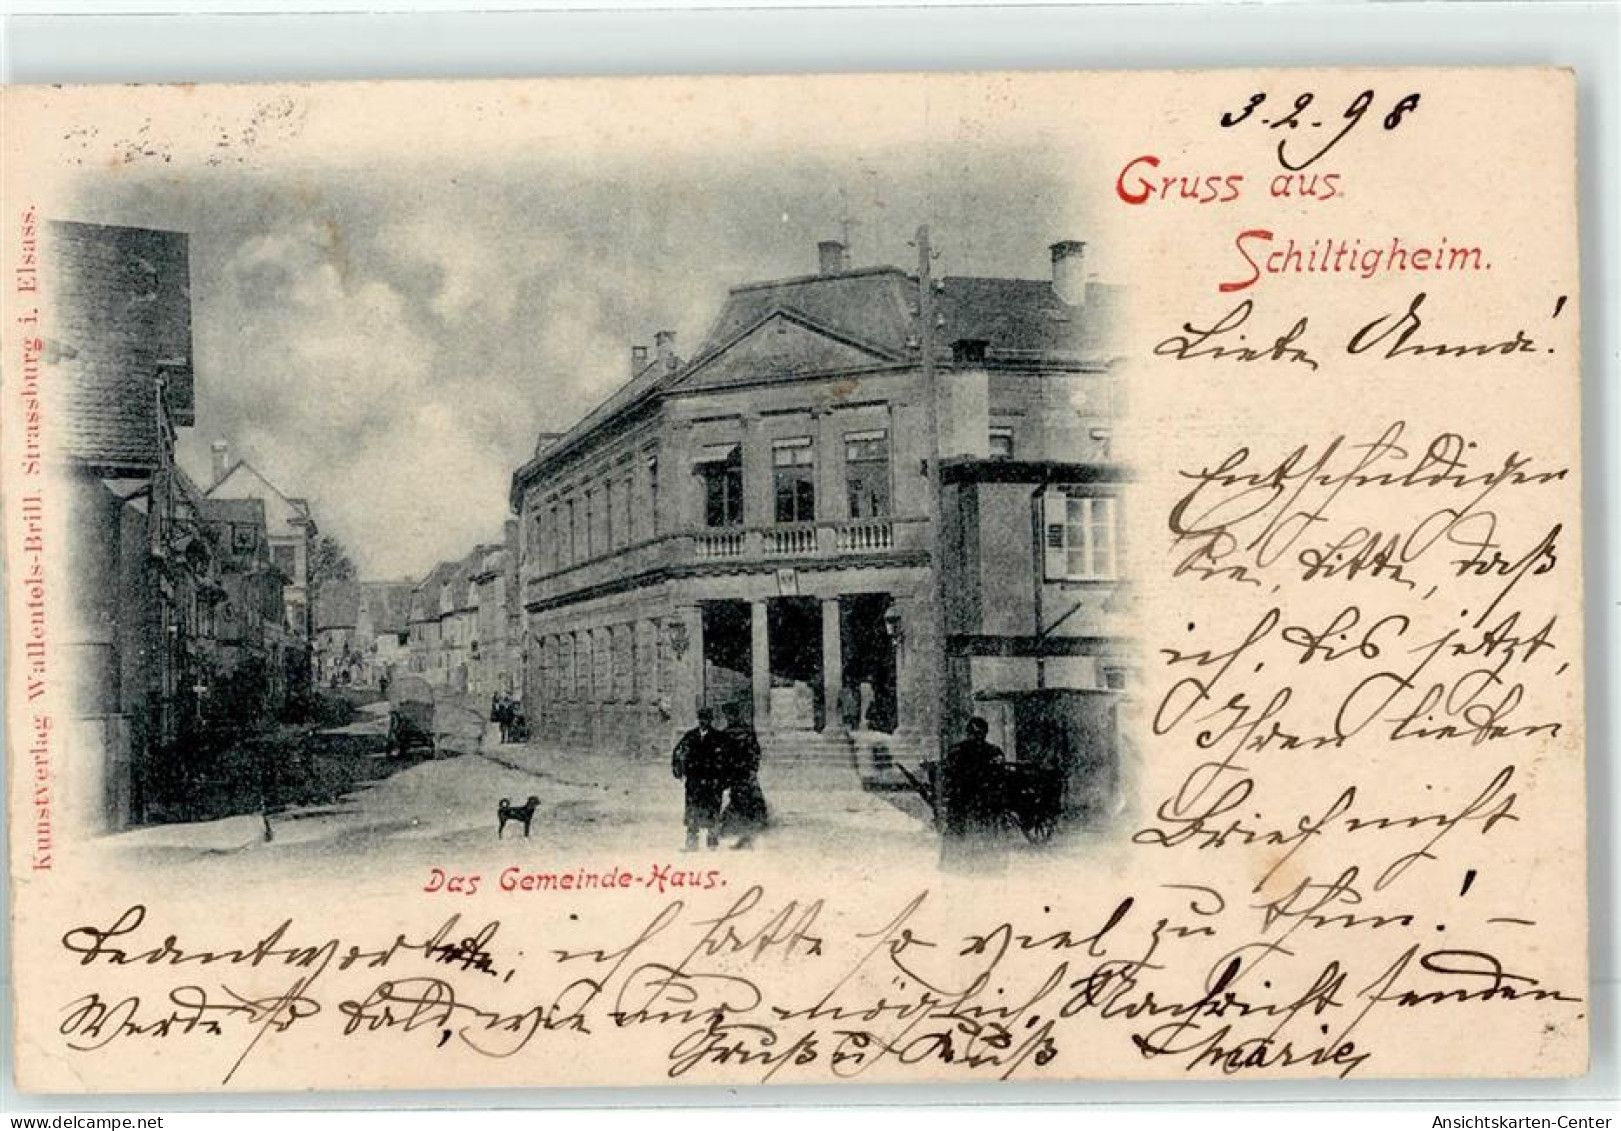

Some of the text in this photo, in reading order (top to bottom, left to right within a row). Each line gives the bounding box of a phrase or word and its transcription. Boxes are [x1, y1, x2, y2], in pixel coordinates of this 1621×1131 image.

[1116, 155, 1244, 205] Gruss
[16, 204, 37, 293] Elsass.
[1218, 230, 1492, 292] Schiltigheim.
[18, 307, 39, 324] i.
[1153, 300, 1318, 370] Liebe
[21, 338, 43, 475] Strassburg
[1283, 606, 1408, 664] bis
[32, 714, 54, 872] Kunstverlag
[1132, 765, 1519, 893] Brief nicht
[423, 863, 727, 895] Das Gemeinde-Haus.
